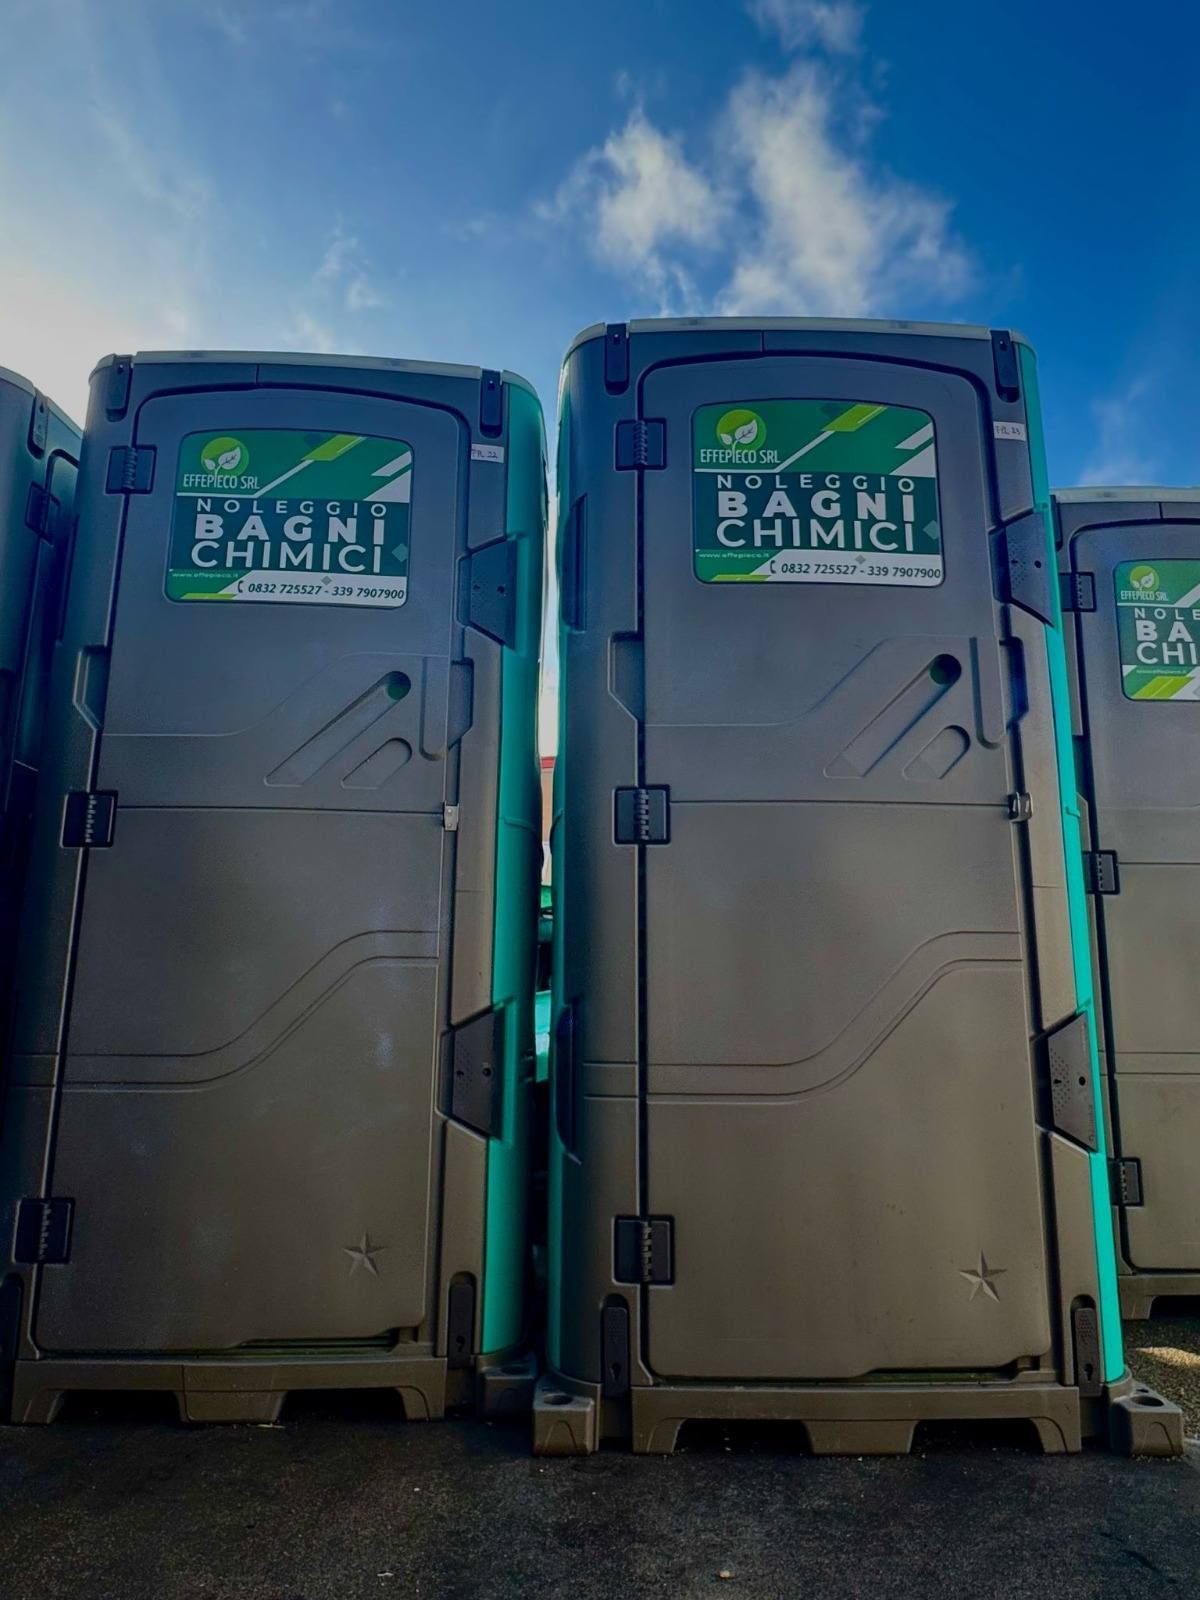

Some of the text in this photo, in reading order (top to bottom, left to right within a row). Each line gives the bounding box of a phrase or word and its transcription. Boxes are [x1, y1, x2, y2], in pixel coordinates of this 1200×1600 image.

[700, 448, 781, 464] EFFEPIECO SRL
[183, 474, 260, 490] EFFEPIECO SRL
[717, 474, 915, 492] NOLEGGIO
[197, 498, 387, 517] NOLEGGIO
[717, 490, 915, 522] BAGNI
[194, 513, 385, 545] BAGNI
[716, 518, 914, 552] CHIMICI
[191, 540, 381, 573] CHIMICI
[781, 563, 810, 574] 0832
[813, 564, 857, 575] 725527
[867, 565, 888, 577] 339
[892, 566, 941, 579] 7907900
[248, 583, 277, 594] 0832
[279, 584, 322, 595] 725527
[332, 585, 354, 597] 339
[356, 587, 404, 600] 7907900
